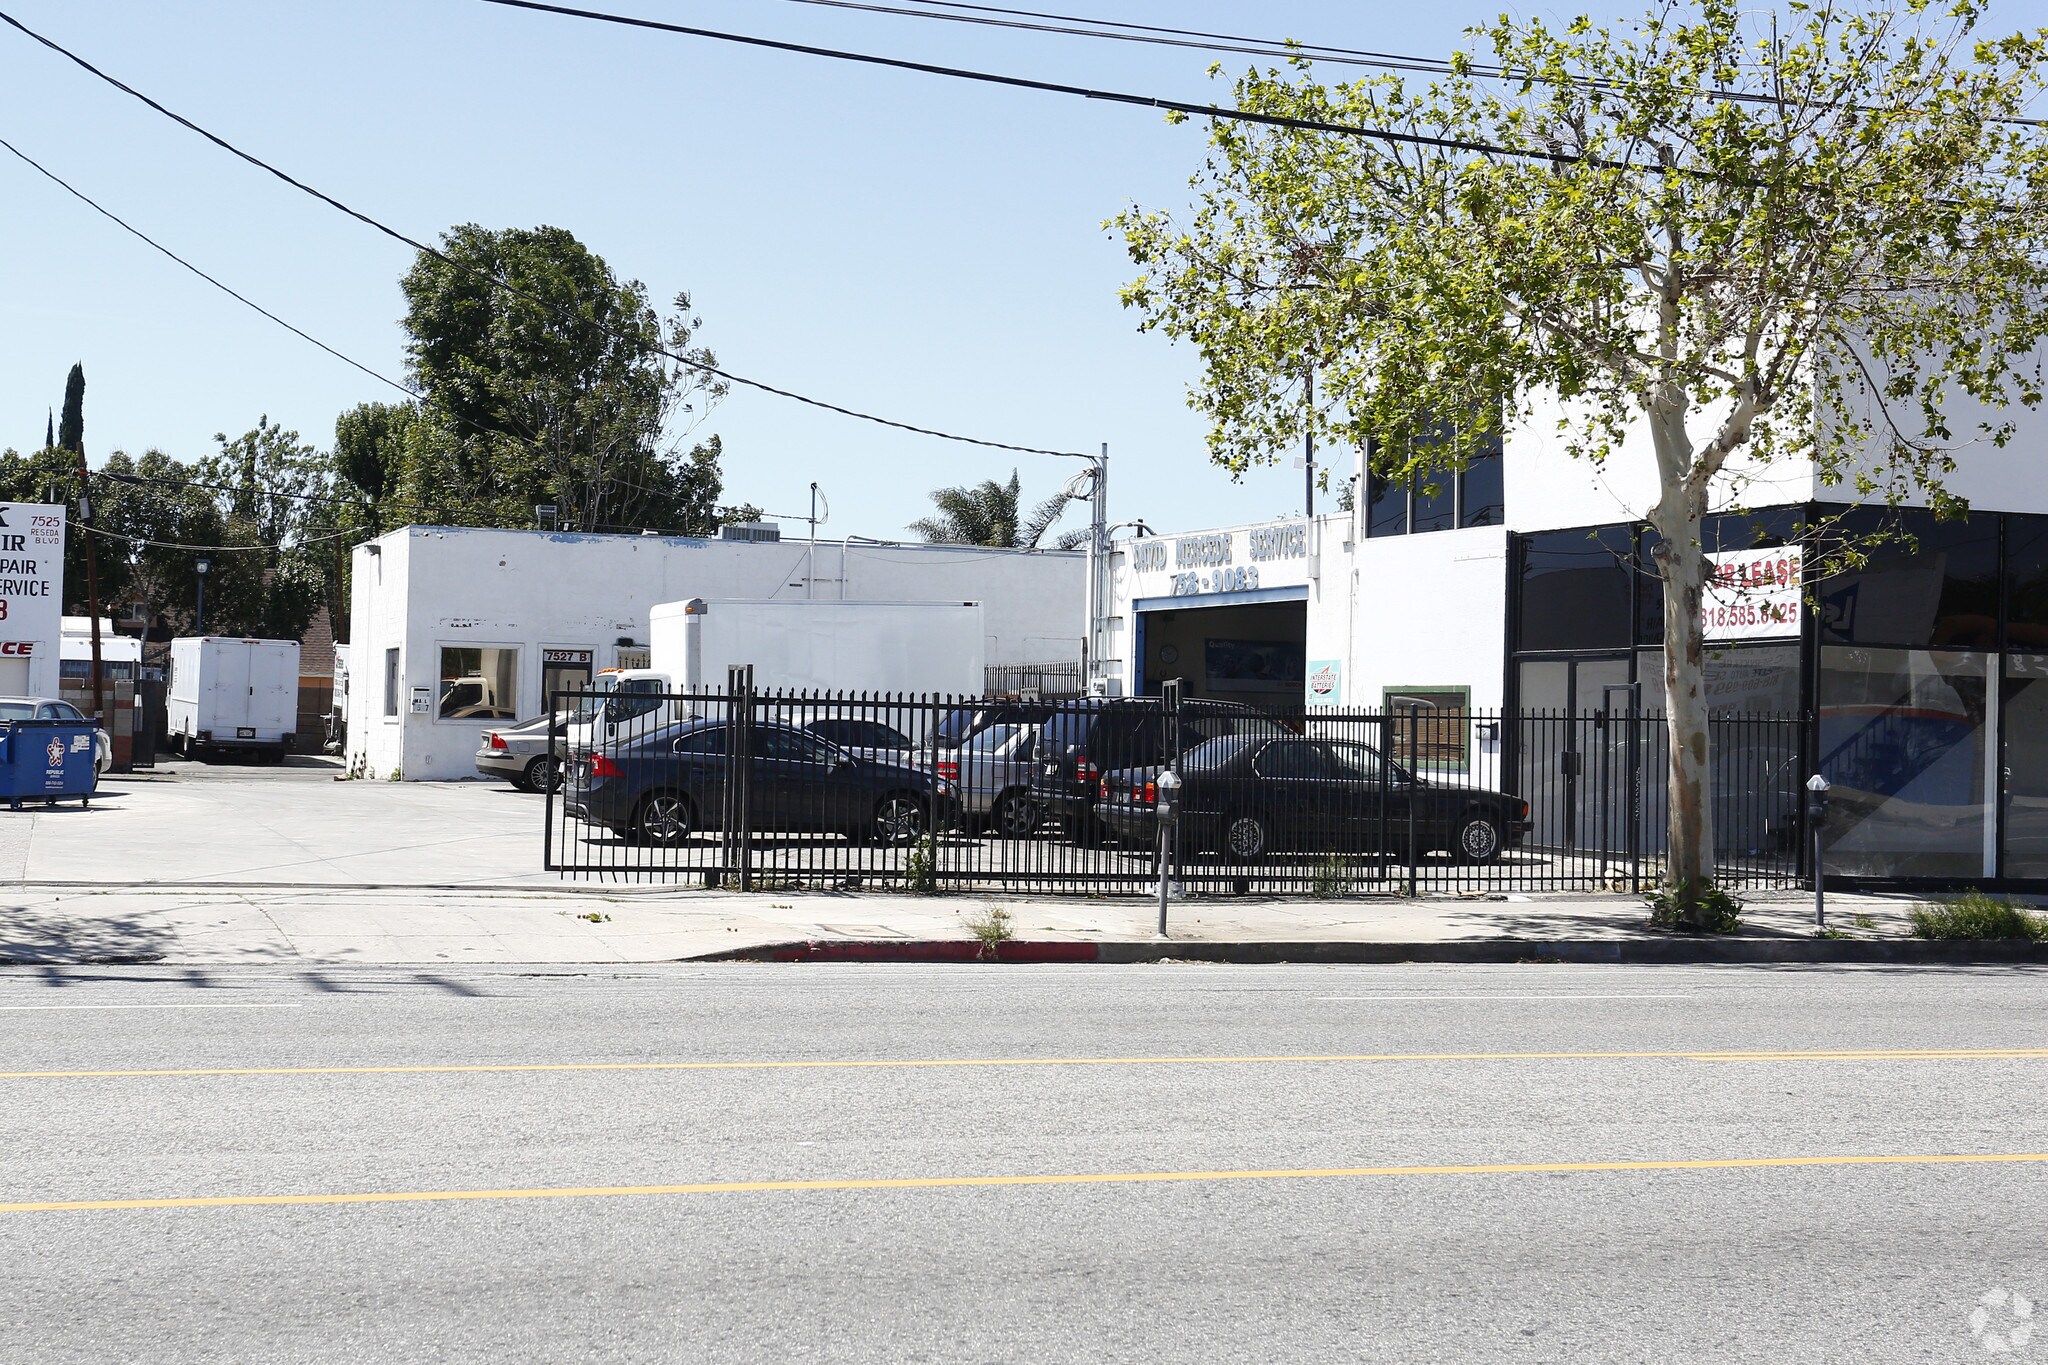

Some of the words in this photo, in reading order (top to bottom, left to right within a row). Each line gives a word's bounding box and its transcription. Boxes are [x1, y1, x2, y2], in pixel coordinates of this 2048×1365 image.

[31, 516, 60, 528] 7525
[30, 528, 59, 537] RESEDA
[1, 534, 26, 552] IR
[35, 537, 60, 545] BLVD
[1133, 541, 1167, 573] DAVID
[1176, 533, 1233, 569] MERCEDE
[1249, 525, 1307, 562] SERVICE
[0, 559, 37, 575] PAIR
[0, 642, 34, 655] CE
[1208, 640, 1236, 649] Quality
[547, 652, 574, 661] 7527
[579, 653, 587, 662] B
[1310, 673, 1337, 681] INTERSTATE
